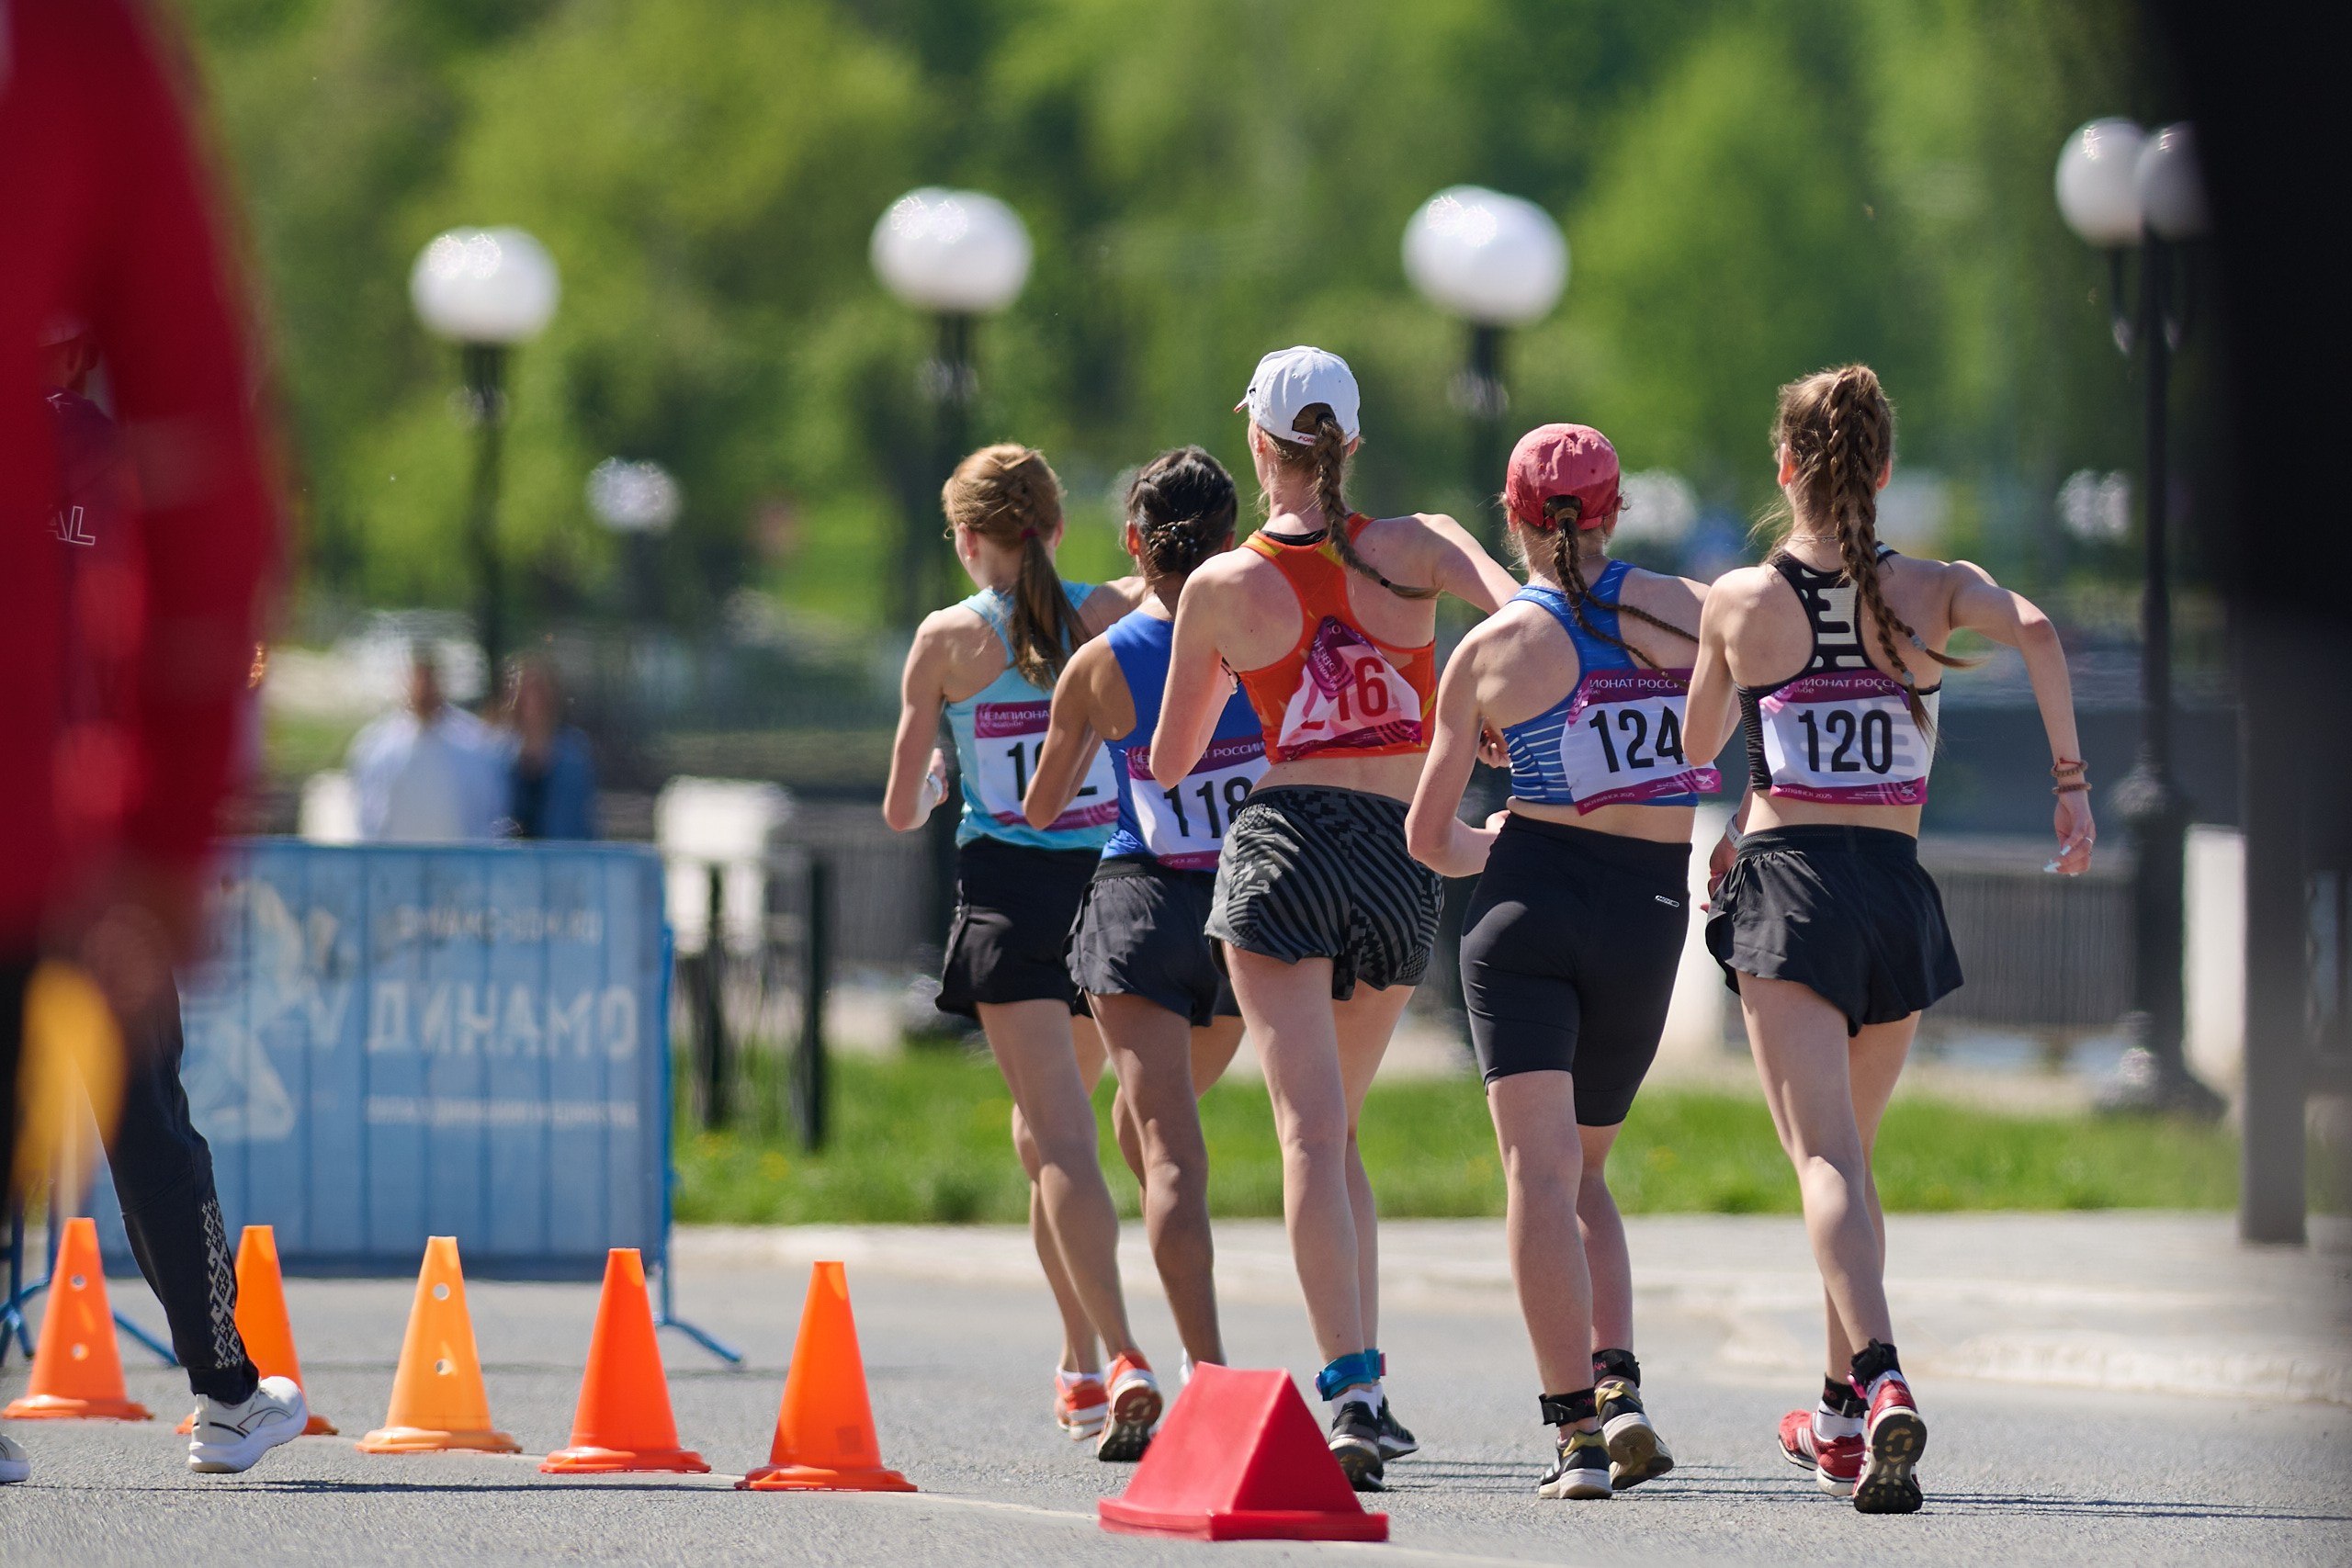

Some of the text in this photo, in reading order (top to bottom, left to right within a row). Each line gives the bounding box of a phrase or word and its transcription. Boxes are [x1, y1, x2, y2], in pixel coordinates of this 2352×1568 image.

[1589, 705, 1684, 773] 124
[1798, 708, 1893, 774] 120
[1163, 776, 1253, 839] 118
[367, 980, 639, 1061] ДИНАМО
